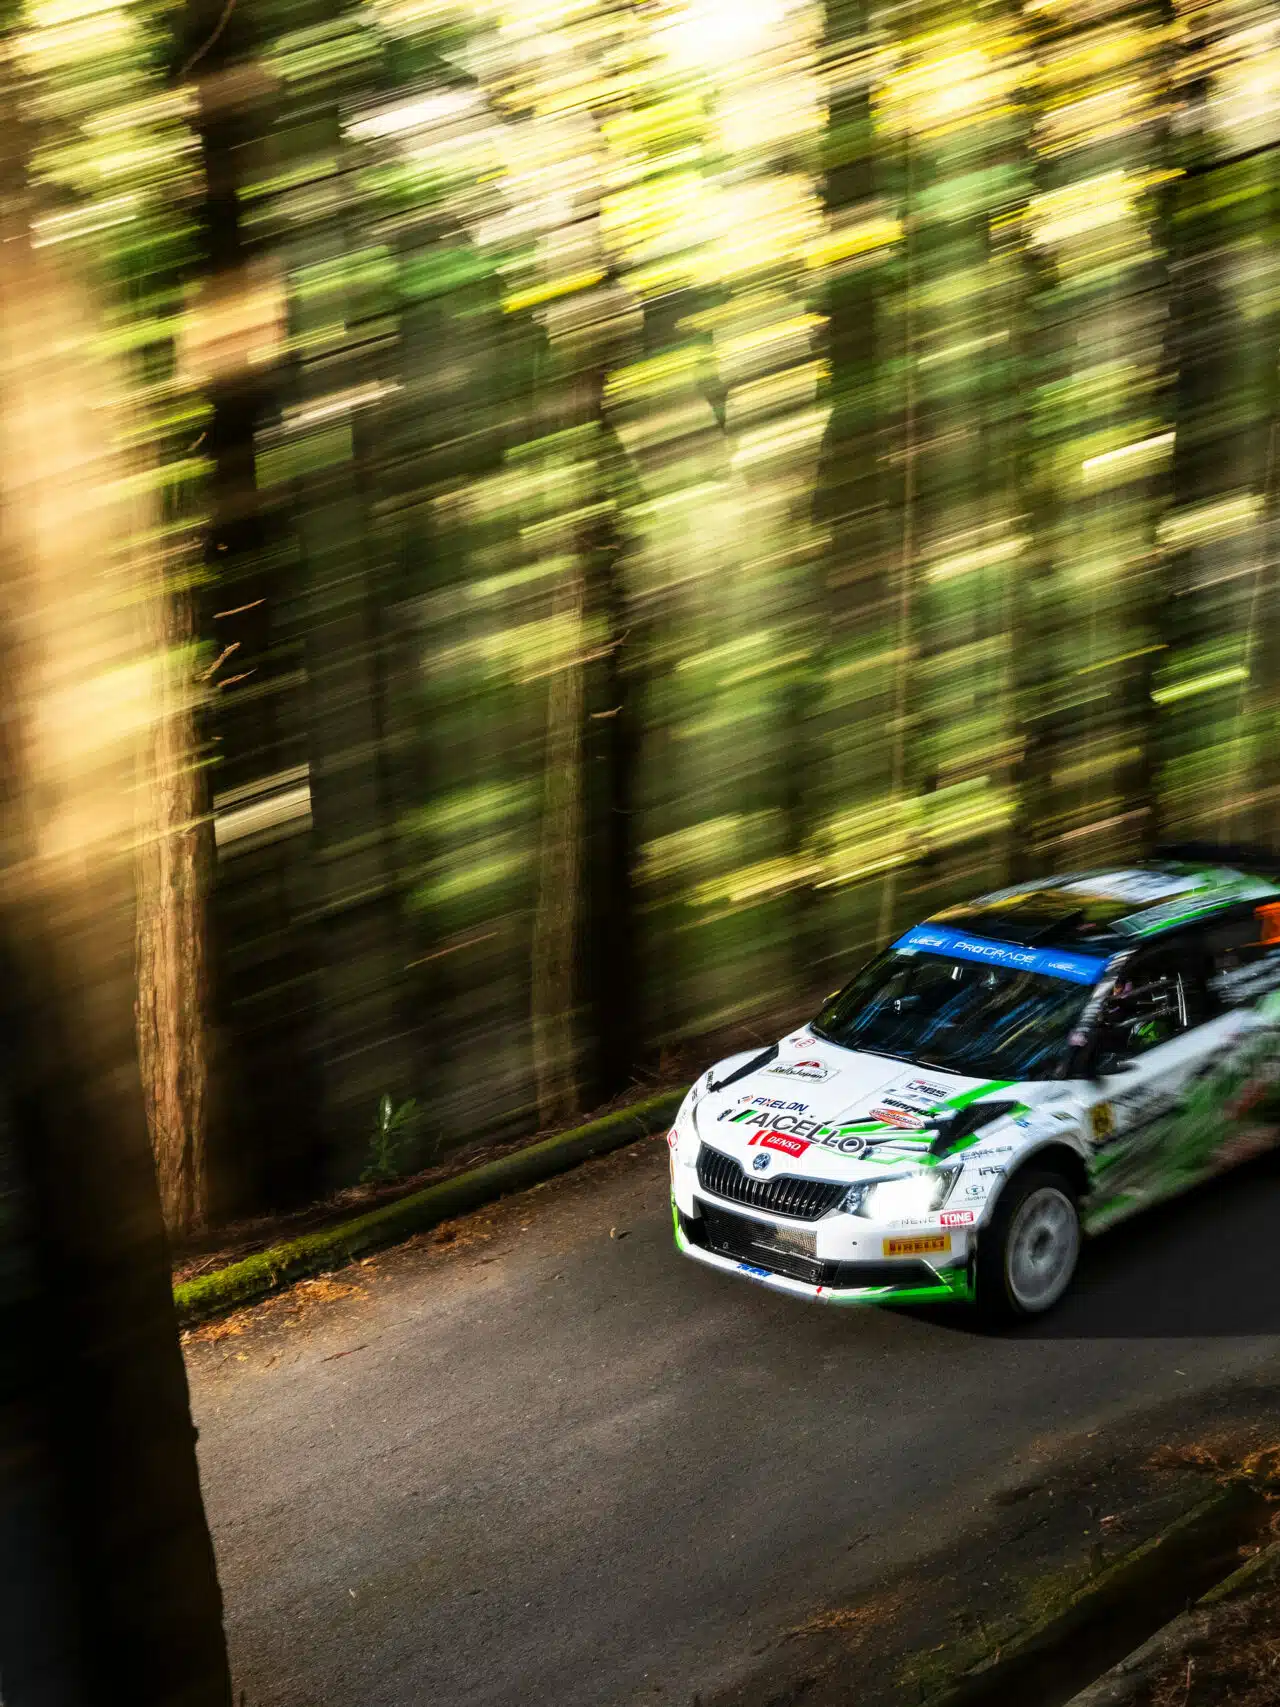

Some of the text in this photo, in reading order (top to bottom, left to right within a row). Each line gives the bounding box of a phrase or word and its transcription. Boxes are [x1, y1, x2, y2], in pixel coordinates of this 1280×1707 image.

[953, 941, 1036, 964] PROGRADE
[905, 1082, 948, 1098] LABS
[752, 1097, 810, 1112] FIXELON
[744, 1112, 866, 1153] AICELLO
[766, 1135, 802, 1151] DENSO
[942, 1212, 972, 1225] TONE
